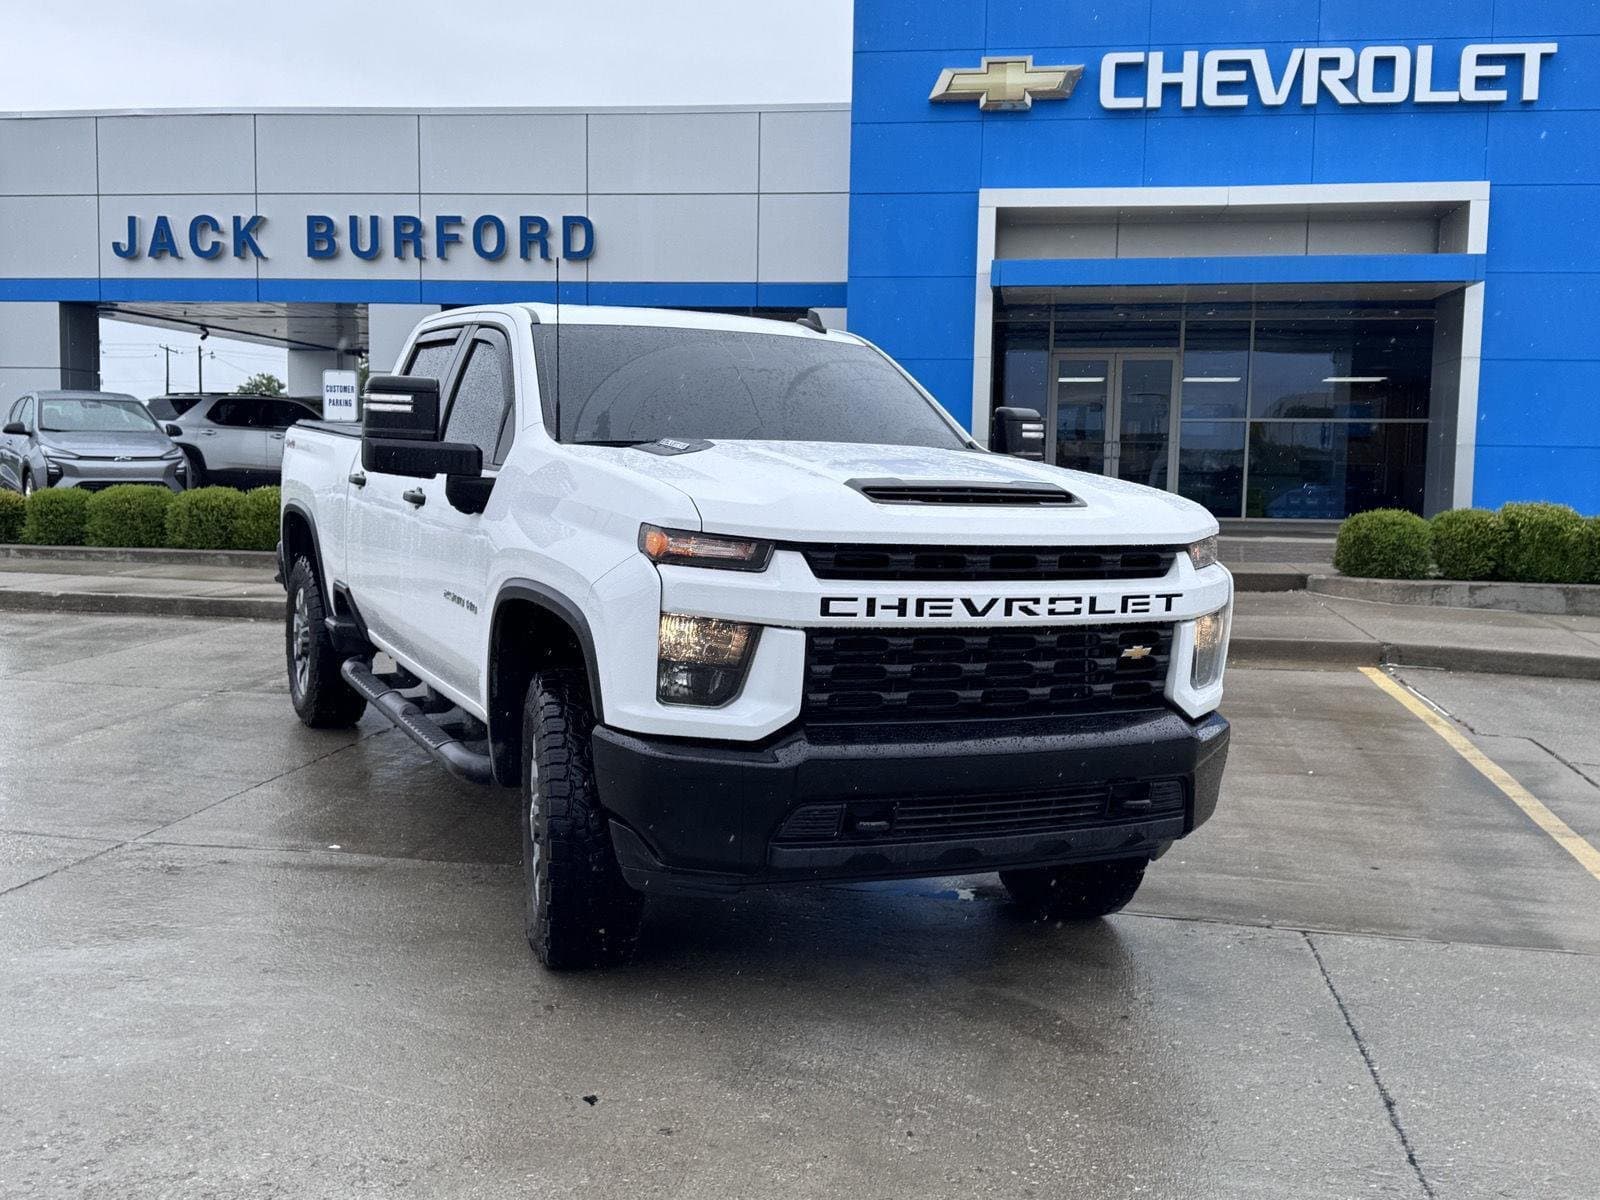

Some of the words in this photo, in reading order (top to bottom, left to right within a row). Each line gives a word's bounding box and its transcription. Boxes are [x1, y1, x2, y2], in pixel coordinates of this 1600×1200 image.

[1100, 43, 1558, 109] CHEVROLET
[112, 214, 268, 260] JACK
[307, 214, 595, 261] BURFORD
[326, 384, 354, 393] CUSTOMER
[329, 398, 352, 407] PARKING
[820, 593, 1183, 618] CHEVROLET
